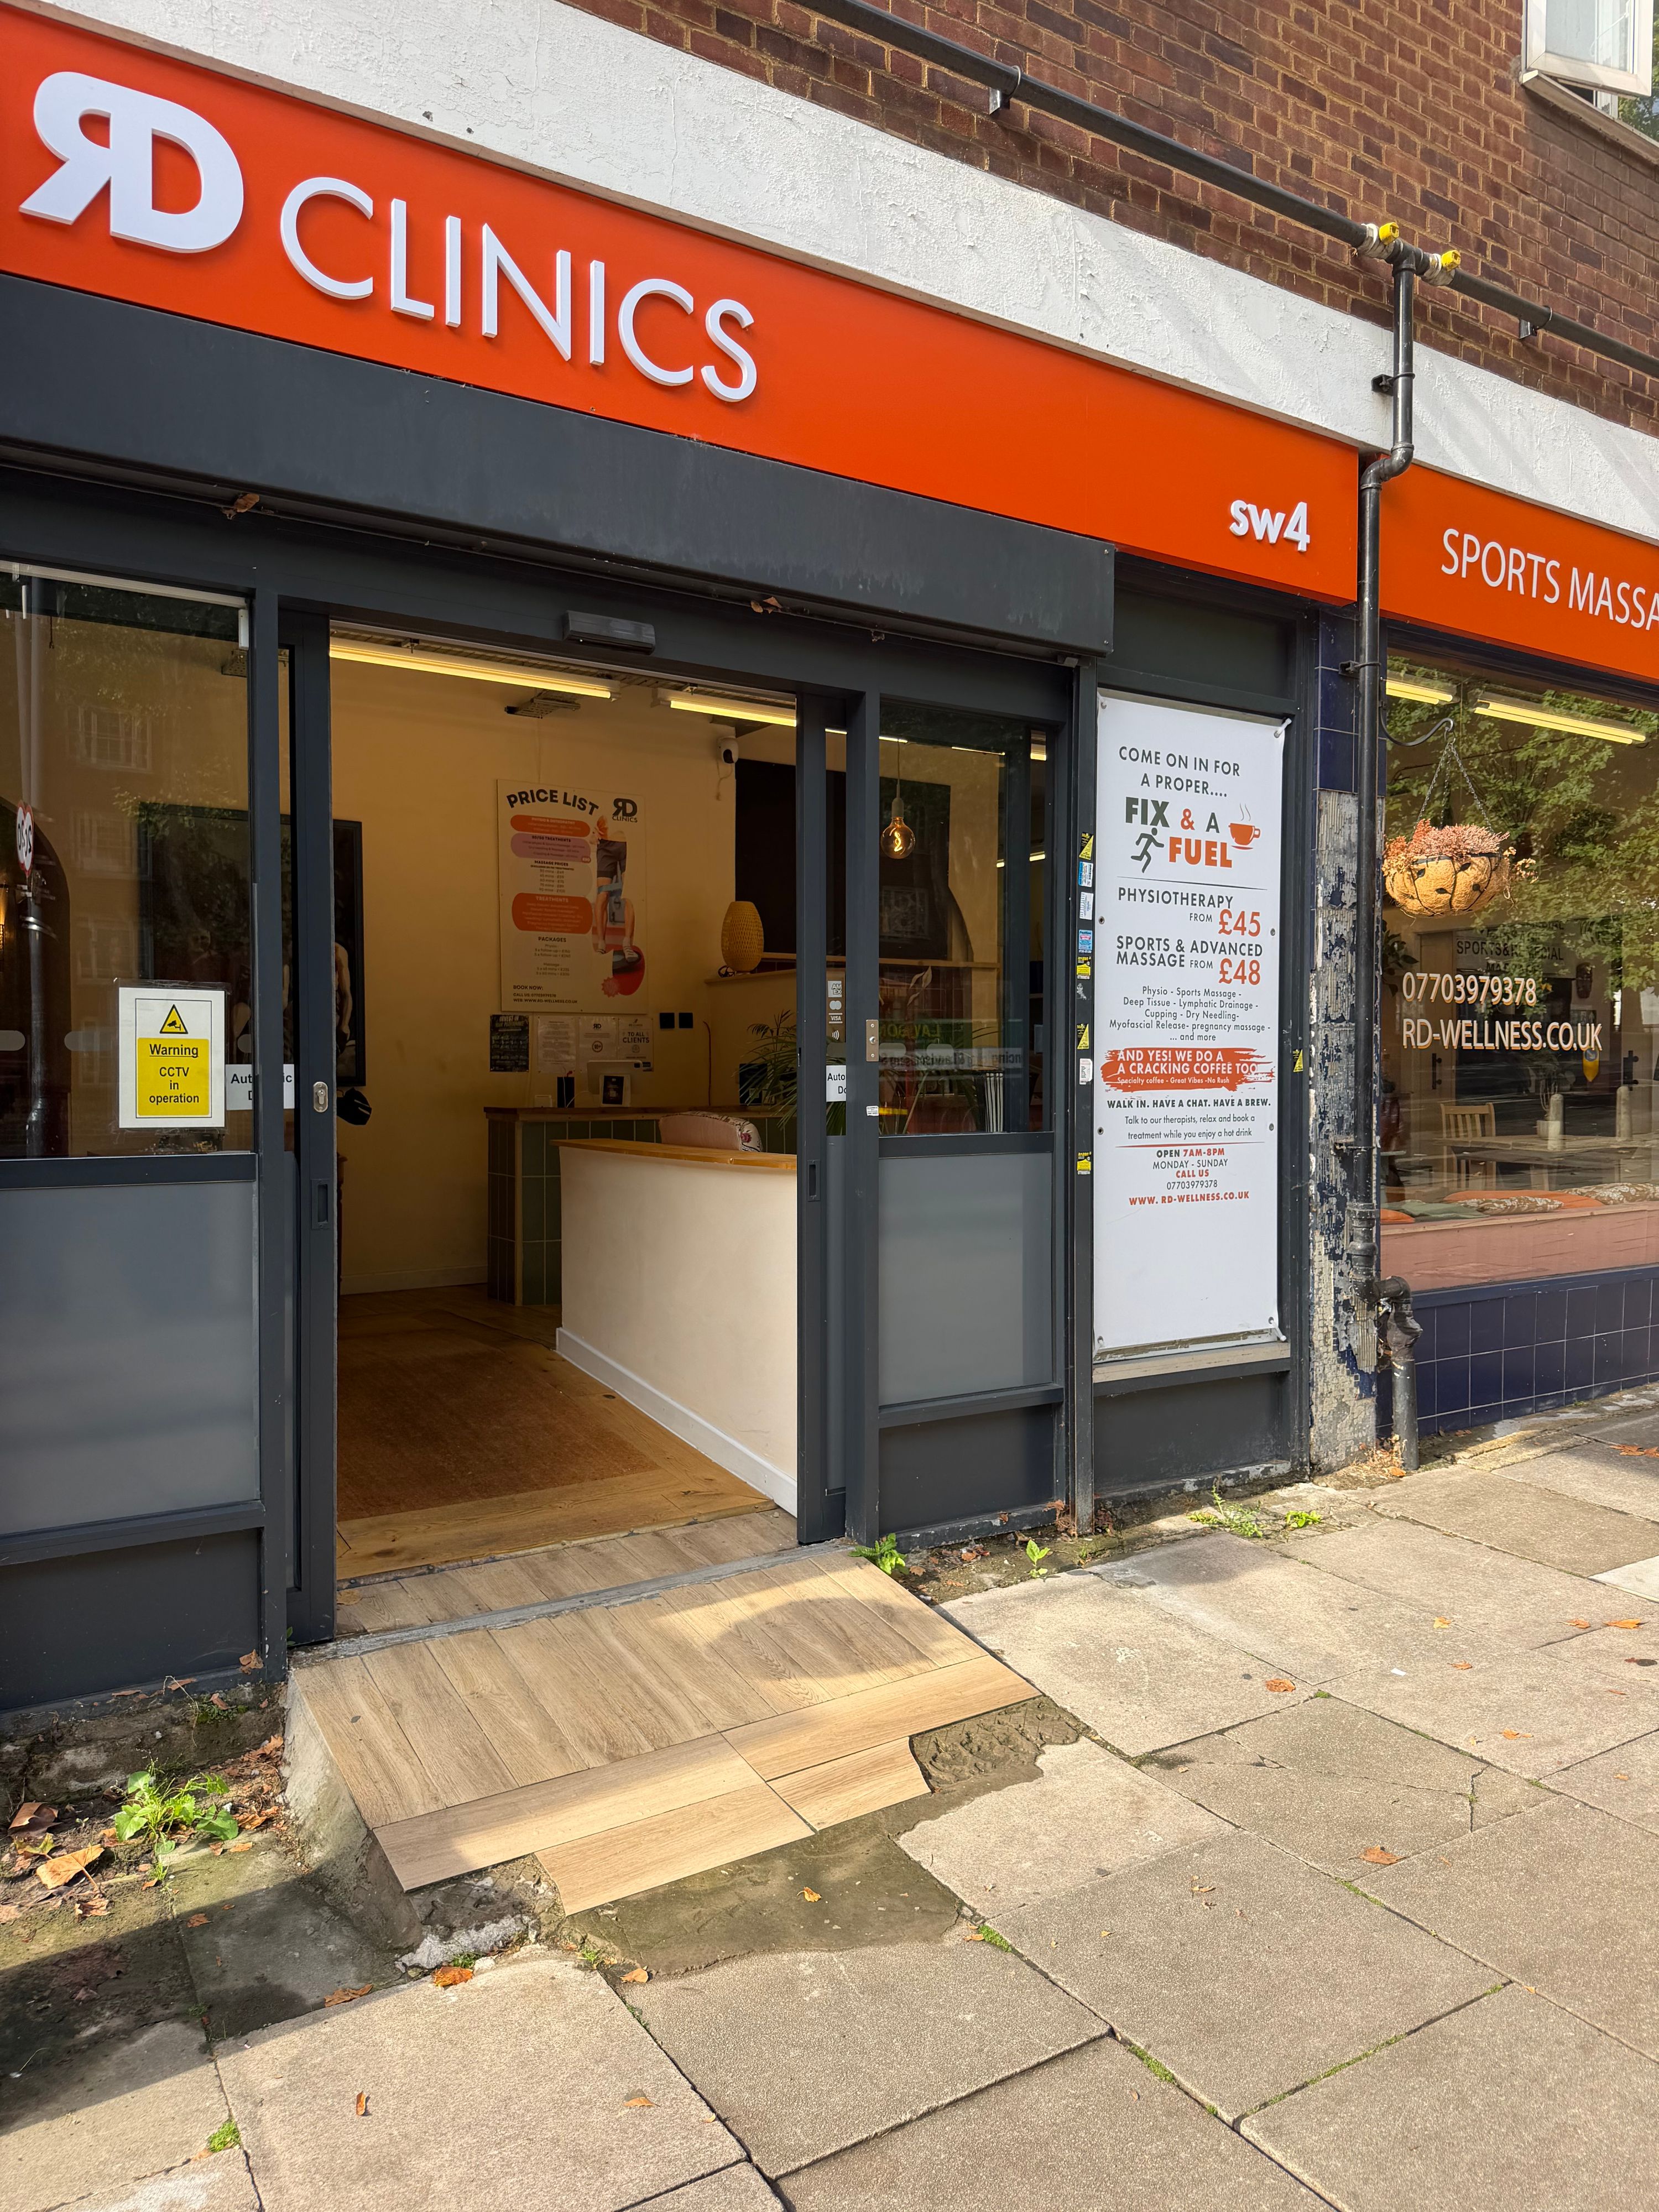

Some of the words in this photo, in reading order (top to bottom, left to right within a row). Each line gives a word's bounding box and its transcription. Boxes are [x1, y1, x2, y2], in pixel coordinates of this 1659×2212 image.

[280, 177, 757, 403] CLINICS
[1229, 499, 1311, 552] sw4
[1441, 528, 1561, 603] SPORTS
[1568, 566, 1659, 631] MASSA
[1119, 746, 1160, 765] COME
[1166, 753, 1188, 769] ON
[1194, 757, 1208, 772] IN
[1214, 760, 1240, 776] FOR
[1141, 773, 1150, 787] A
[1156, 775, 1227, 797] PROPER....
[507, 789, 558, 808] PRICE
[563, 792, 599, 816] LIST
[1125, 796, 1170, 828] FIX
[1181, 808, 1195, 830] &
[1206, 812, 1220, 833] A
[1169, 837, 1232, 868] FUEL
[1119, 887, 1233, 909] PHYSIOTHERAPY
[1190, 913, 1212, 922] FROM
[1218, 909, 1260, 937] £45
[1117, 935, 1170, 952] SPORTS
[1176, 939, 1185, 952] &
[1190, 940, 1262, 957] ADVANCED
[1117, 951, 1185, 967] MASSAGE
[1190, 960, 1213, 969] FROM
[1219, 958, 1260, 985] £48
[1142, 985, 1167, 997] Physio
[1177, 987, 1201, 998] Sports
[1203, 988, 1236, 1000] Massage
[1402, 972, 1537, 1006] 07703979378
[1124, 997, 1144, 1008] Deep
[1147, 998, 1170, 1006] Tissue
[1180, 999, 1217, 1010] Lymphatic
[1220, 1000, 1253, 1011] Drainage
[1145, 1009, 1177, 1020] Cupping
[1186, 1010, 1199, 1021] Dry
[1203, 1010, 1239, 1021] Needling-
[1109, 1019, 1152, 1030] Myofascial
[1156, 1020, 1189, 1029] Release-
[1192, 1023, 1231, 1033] pregnancy
[1234, 1025, 1265, 1033] massage
[1402, 1018, 1603, 1051] RD-WELLNESS.CO.UK
[149, 1044, 199, 1058] Warning
[1118, 1050, 1144, 1061] AND
[1148, 1051, 1171, 1061] YES!
[1175, 1051, 1192, 1061] WE
[1196, 1051, 1212, 1062] DO
[1216, 1052, 1223, 1061] A
[159, 1067, 189, 1077] CCTV
[1118, 1063, 1125, 1074] A
[1129, 1063, 1190, 1074] CRACKING
[1194, 1063, 1232, 1074] COFFEE
[1235, 1063, 1257, 1074] TOO
[169, 1080, 179, 1090] in
[149, 1093, 199, 1105] operation
[1107, 1100, 1133, 1108] WALK
[1152, 1099, 1175, 1108] HAVE
[1125, 1115, 1139, 1124] Talk
[1164, 1115, 1197, 1125] therapists,
[1200, 1114, 1217, 1123] relax
[1218, 1114, 1231, 1122] and
[1233, 1113, 1249, 1121] book
[1164, 1129, 1182, 1138] while
[1224, 1128, 1234, 1136] hot
[1236, 1128, 1252, 1136] drink
[1156, 1149, 1180, 1158] OPEN
[1183, 1148, 1224, 1157] 7AM-8PM
[1153, 1160, 1189, 1170] MONDAY
[1197, 1159, 1228, 1167] SUNDAY
[1176, 1170, 1196, 1178] CALL
[1167, 1180, 1217, 1190] 07703979378
